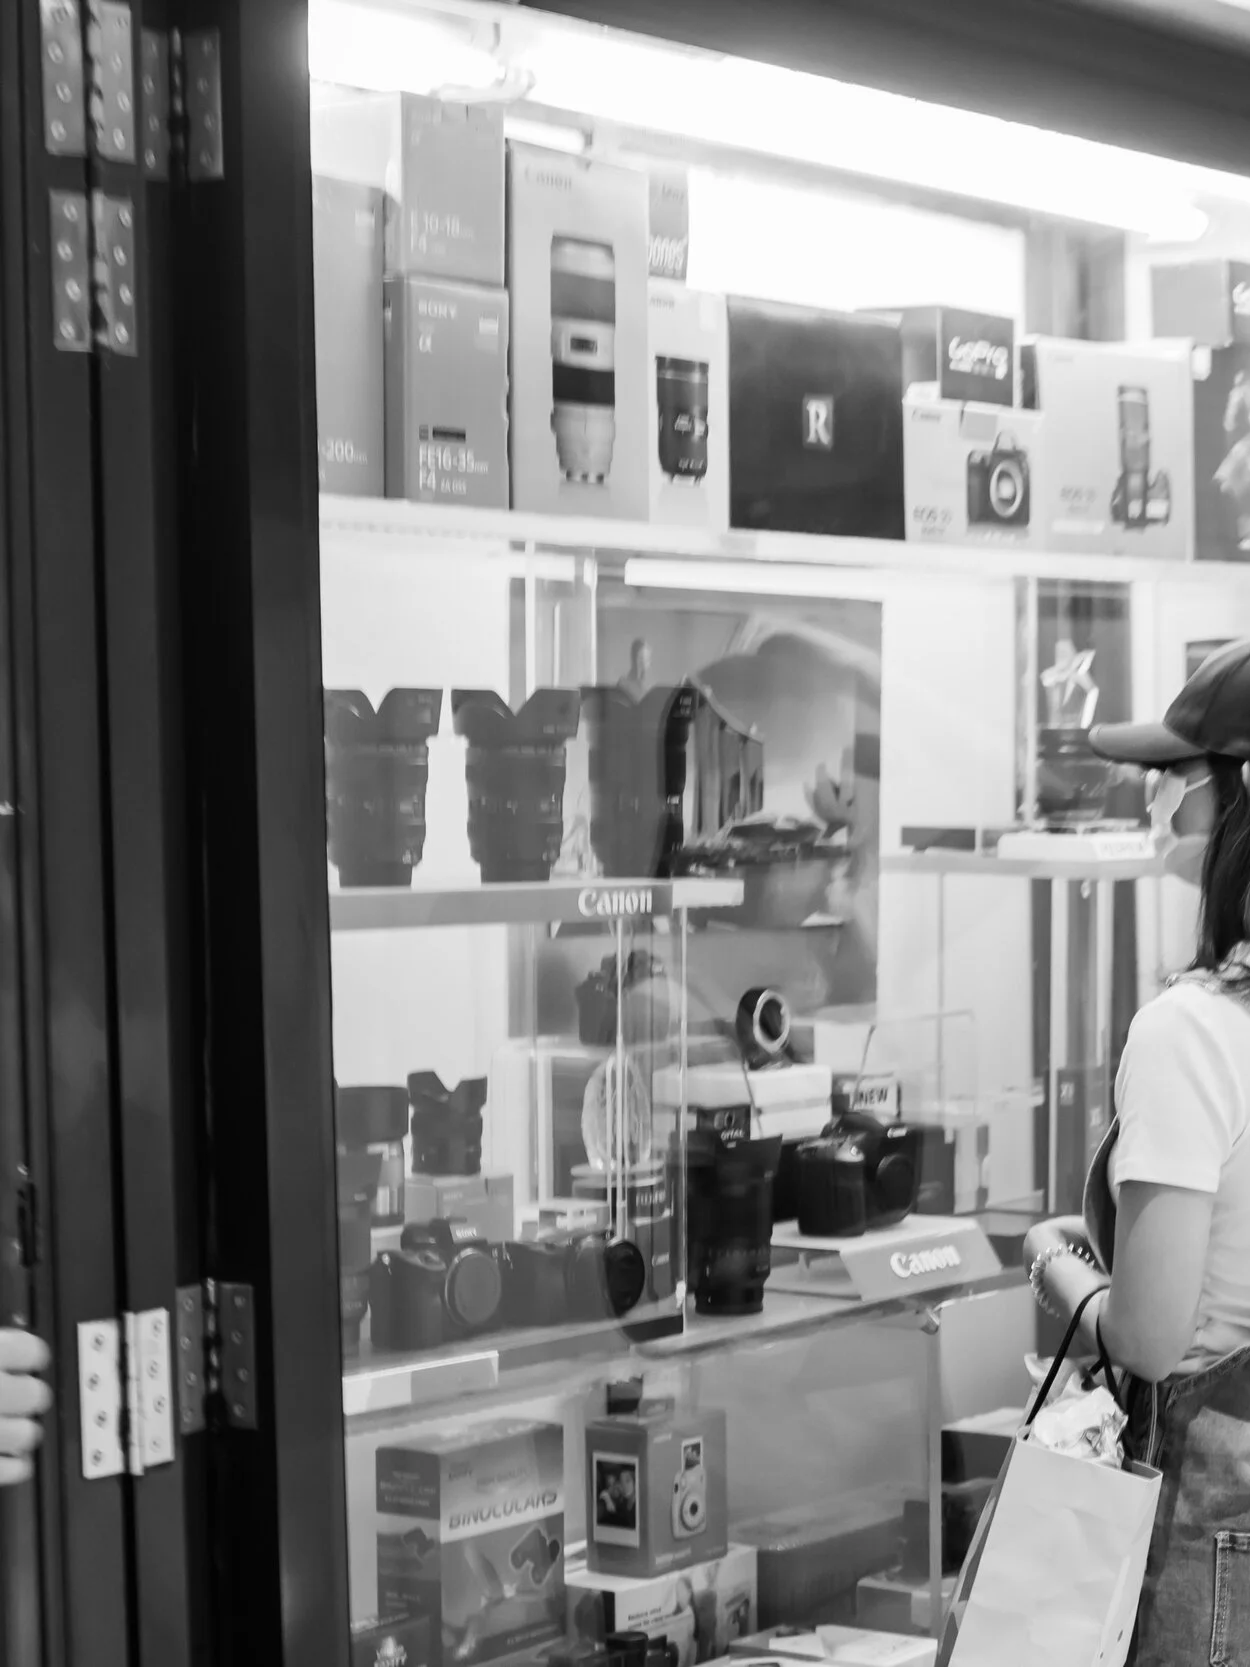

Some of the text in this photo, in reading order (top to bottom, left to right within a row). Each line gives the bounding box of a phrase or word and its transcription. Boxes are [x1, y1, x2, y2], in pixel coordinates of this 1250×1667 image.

[418, 298, 458, 320] SONY
[805, 398, 832, 447] R
[577, 887, 653, 918] Canon
[889, 1244, 962, 1279] Canon
